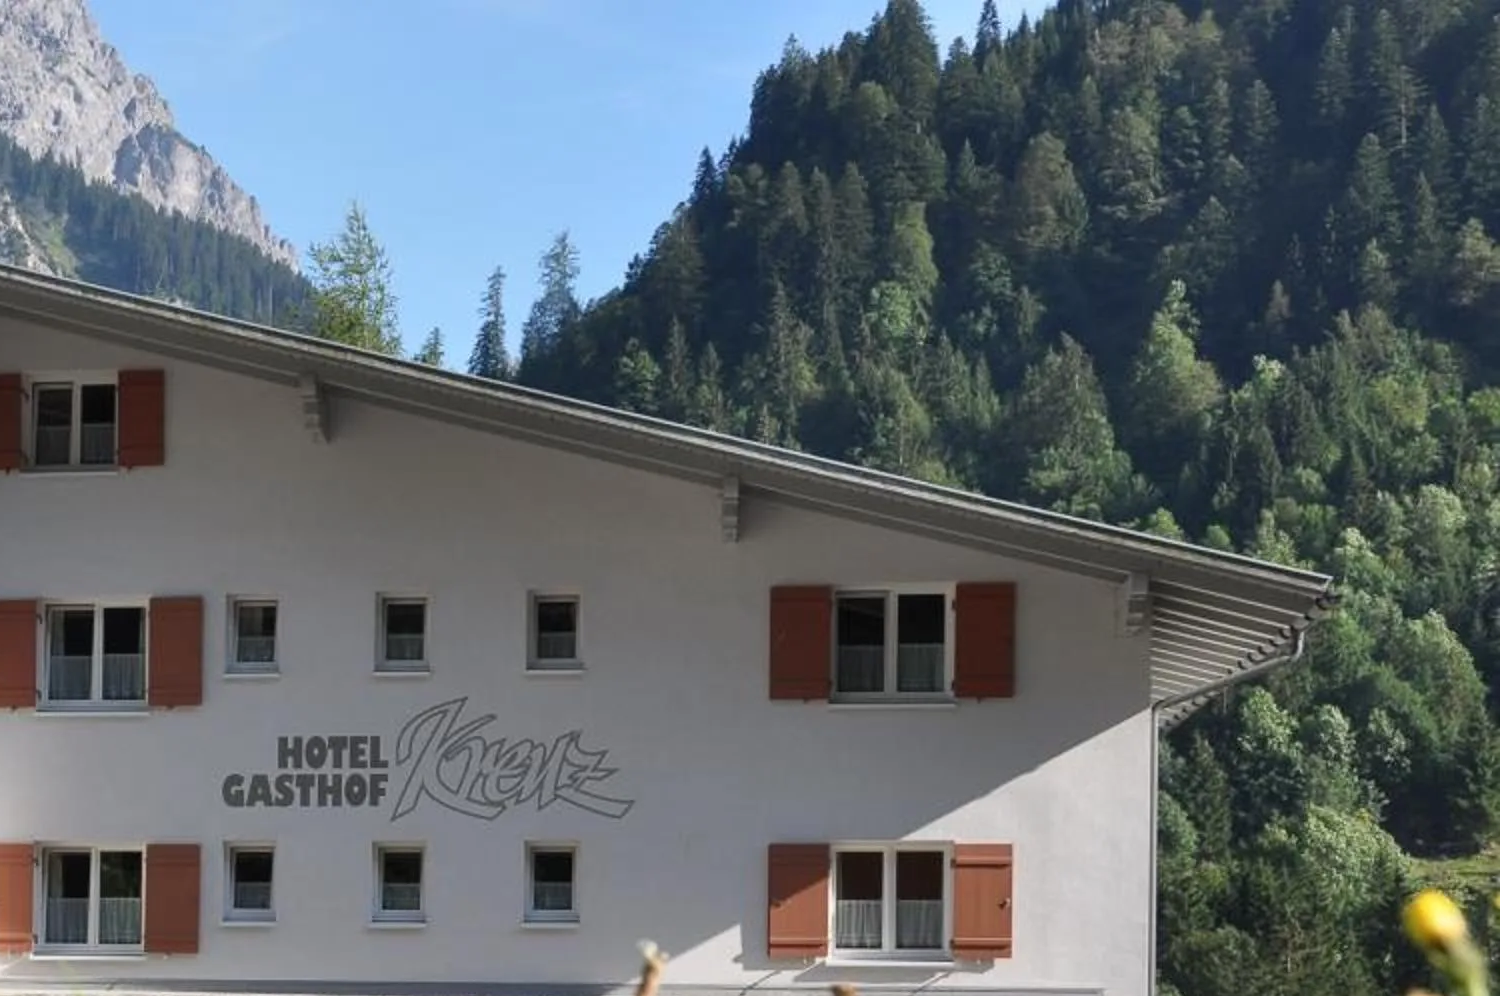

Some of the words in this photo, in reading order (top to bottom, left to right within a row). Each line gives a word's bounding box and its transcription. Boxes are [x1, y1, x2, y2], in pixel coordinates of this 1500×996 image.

[277, 735, 389, 769] HOTEL
[391, 697, 635, 821] Kreuz
[222, 773, 389, 807] GASTHOF
